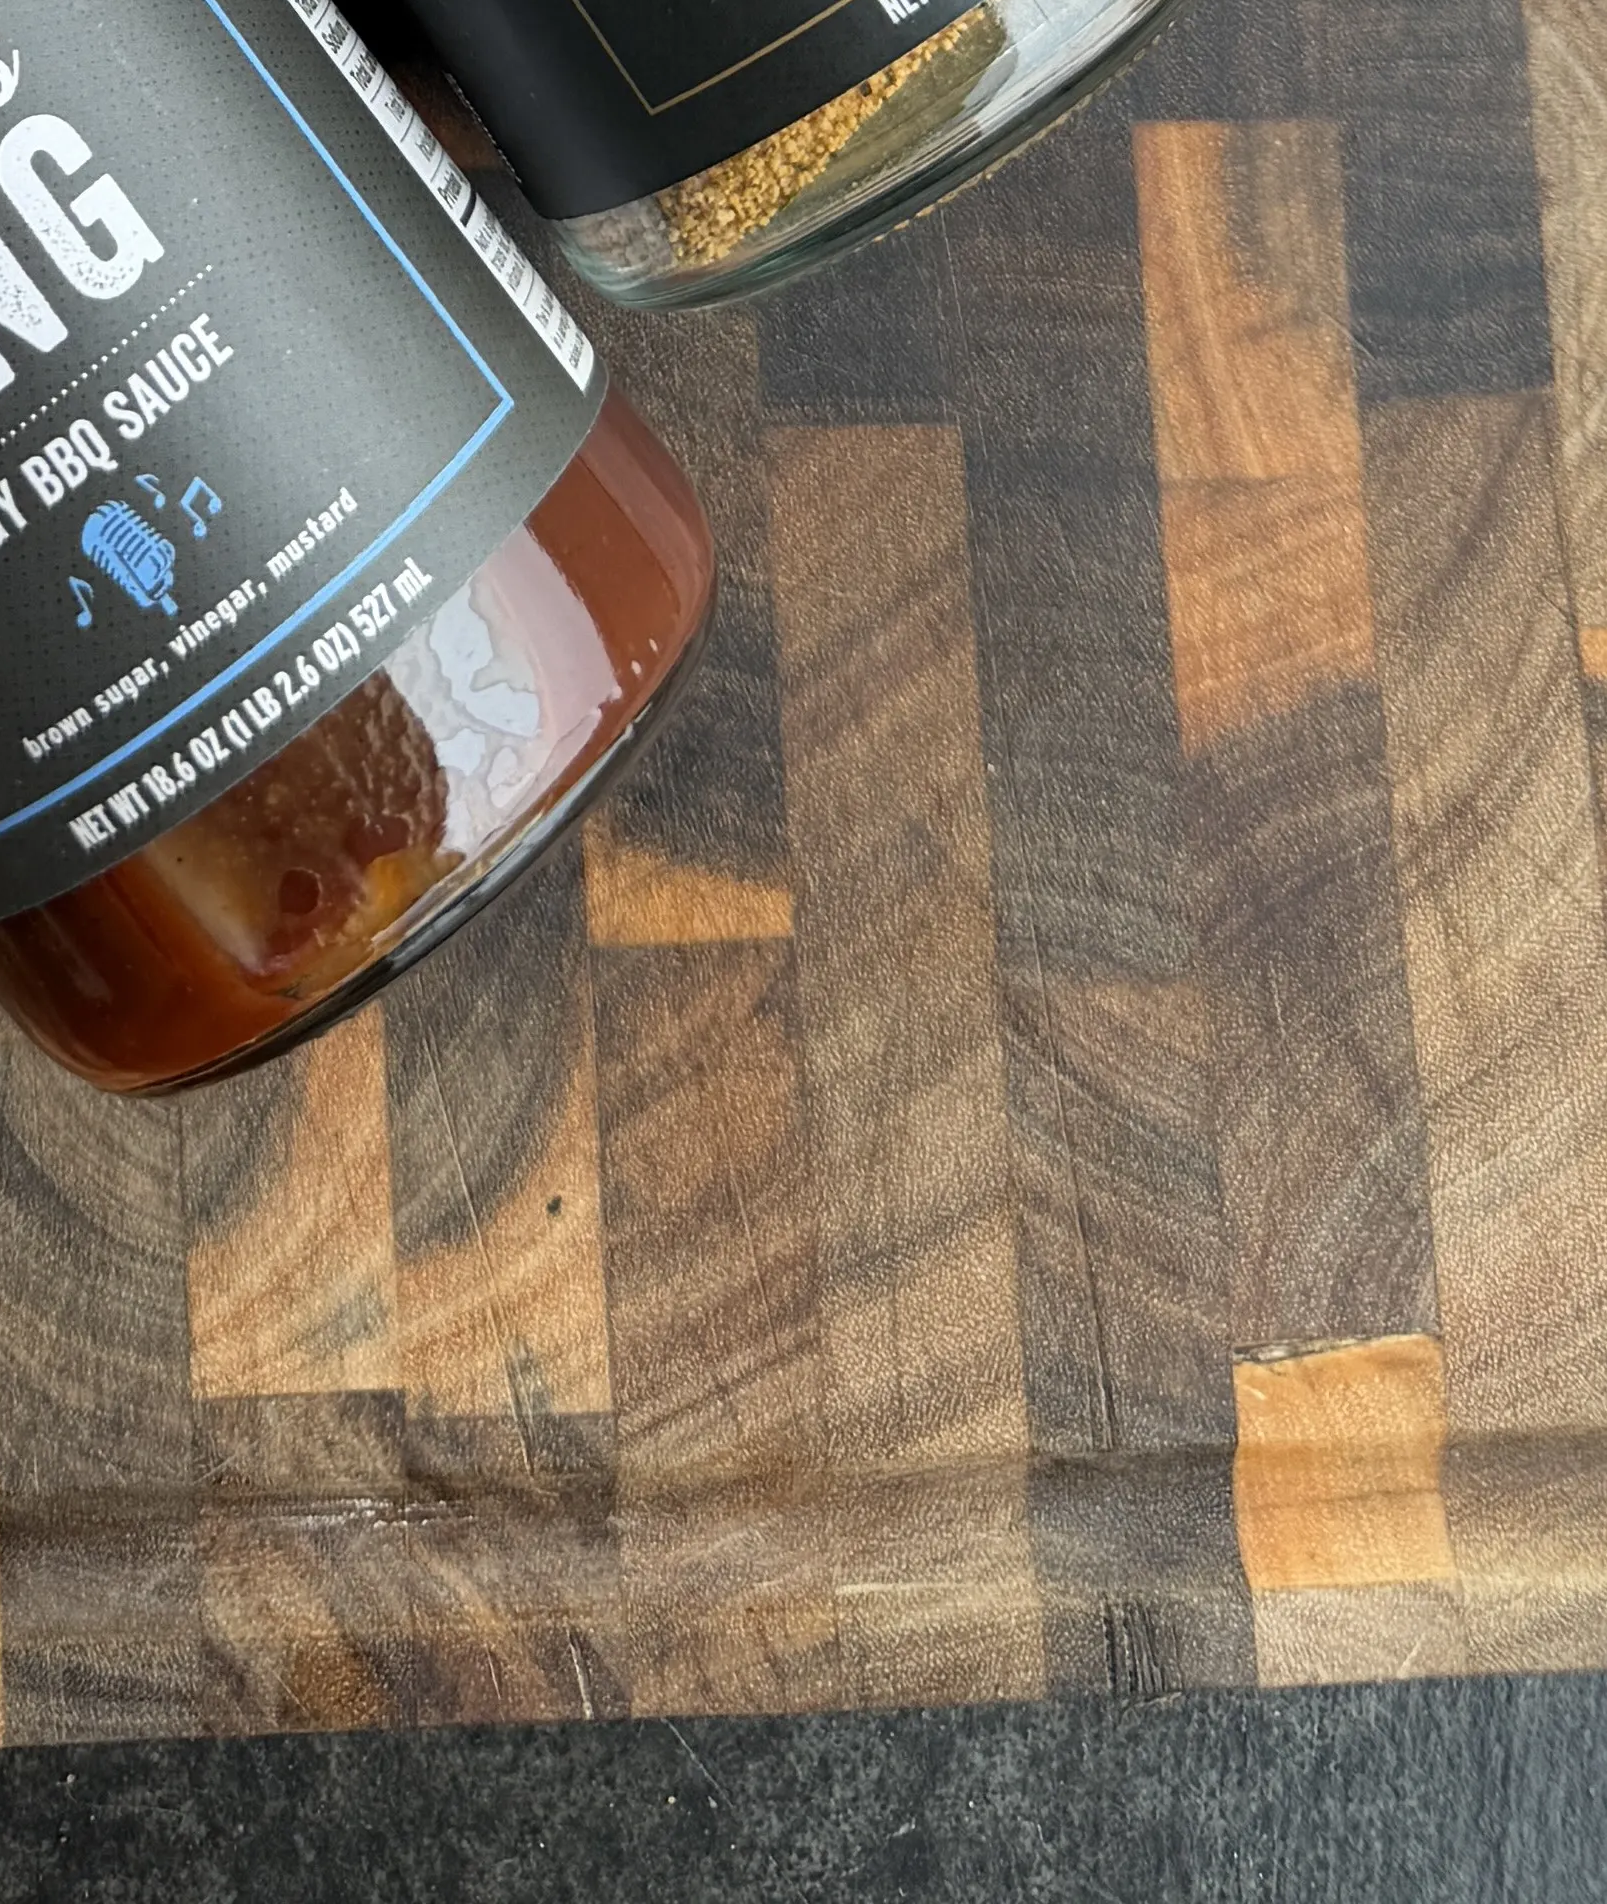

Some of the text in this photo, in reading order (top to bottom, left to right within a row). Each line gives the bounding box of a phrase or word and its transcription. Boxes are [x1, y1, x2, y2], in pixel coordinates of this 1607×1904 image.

[20, 418, 118, 509] BBQ
[103, 312, 234, 440] SAUCE
[22, 487, 357, 760] brown sugar, vinegar, mustard
[68, 557, 433, 851] NET WT 18.6 OZ (1 LB 2.6 OZ) 527 mL
